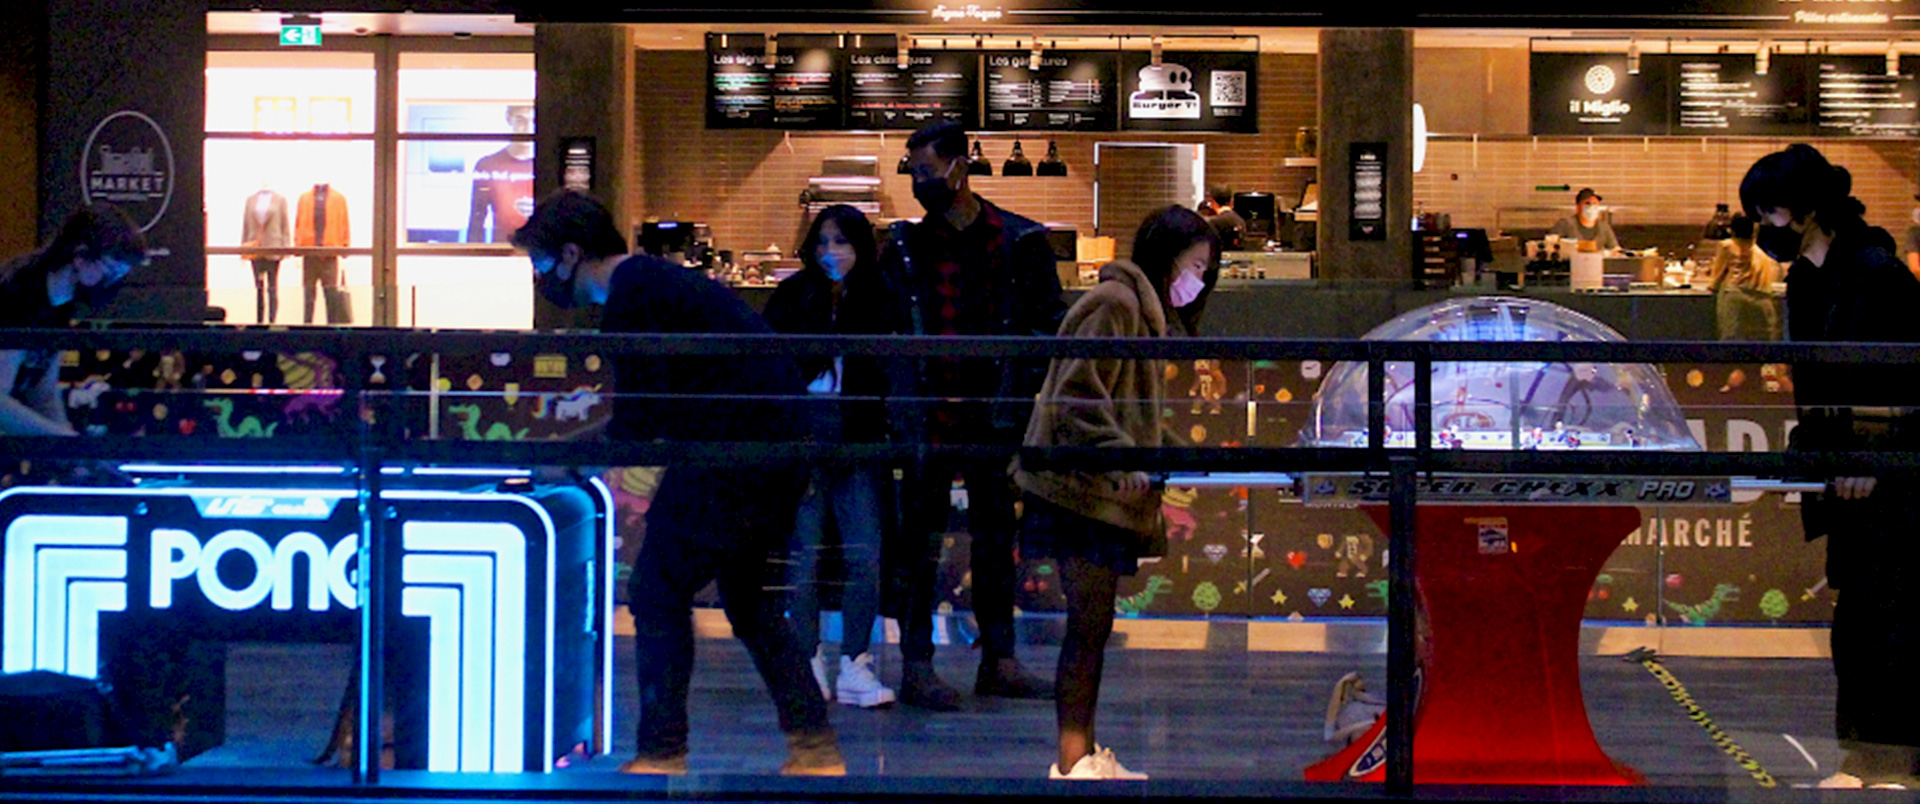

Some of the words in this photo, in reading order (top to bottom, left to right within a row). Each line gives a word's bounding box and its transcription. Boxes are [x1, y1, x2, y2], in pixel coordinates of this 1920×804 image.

[713, 54, 733, 64] Les
[735, 53, 794, 66] signares
[850, 54, 872, 64] Les
[873, 54, 932, 66] clasques
[989, 55, 1009, 66] Les
[1011, 56, 1067, 68] gartures
[1132, 101, 1181, 110] Burger
[1583, 100, 1631, 116] Miglio
[91, 177, 164, 191] MARKET
[1349, 479, 1478, 495] SUER
[1637, 480, 1696, 499] PRO
